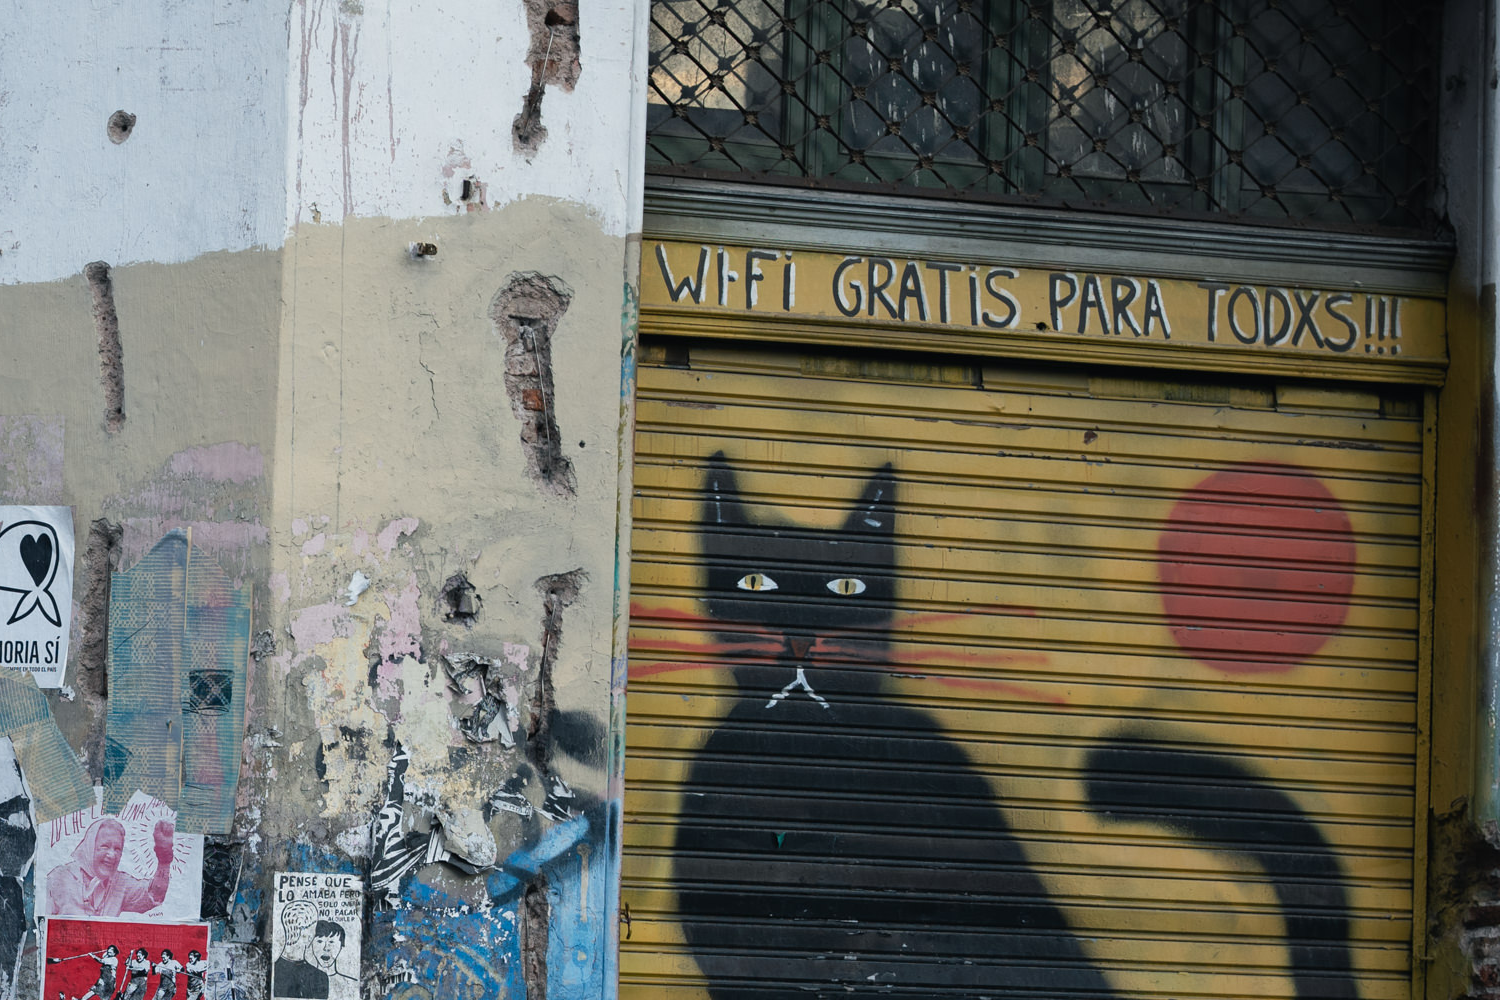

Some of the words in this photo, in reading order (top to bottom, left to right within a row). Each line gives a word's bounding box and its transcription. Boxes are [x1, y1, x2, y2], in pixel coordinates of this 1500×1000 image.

[1050, 271, 1172, 340] PARA
[44, 635, 61, 664] SÍ
[325, 876, 352, 888] QUE
[278, 890, 295, 903] LO
[302, 889, 336, 899] AMABA
[339, 890, 361, 899] PERO
[319, 909, 330, 917] NO
